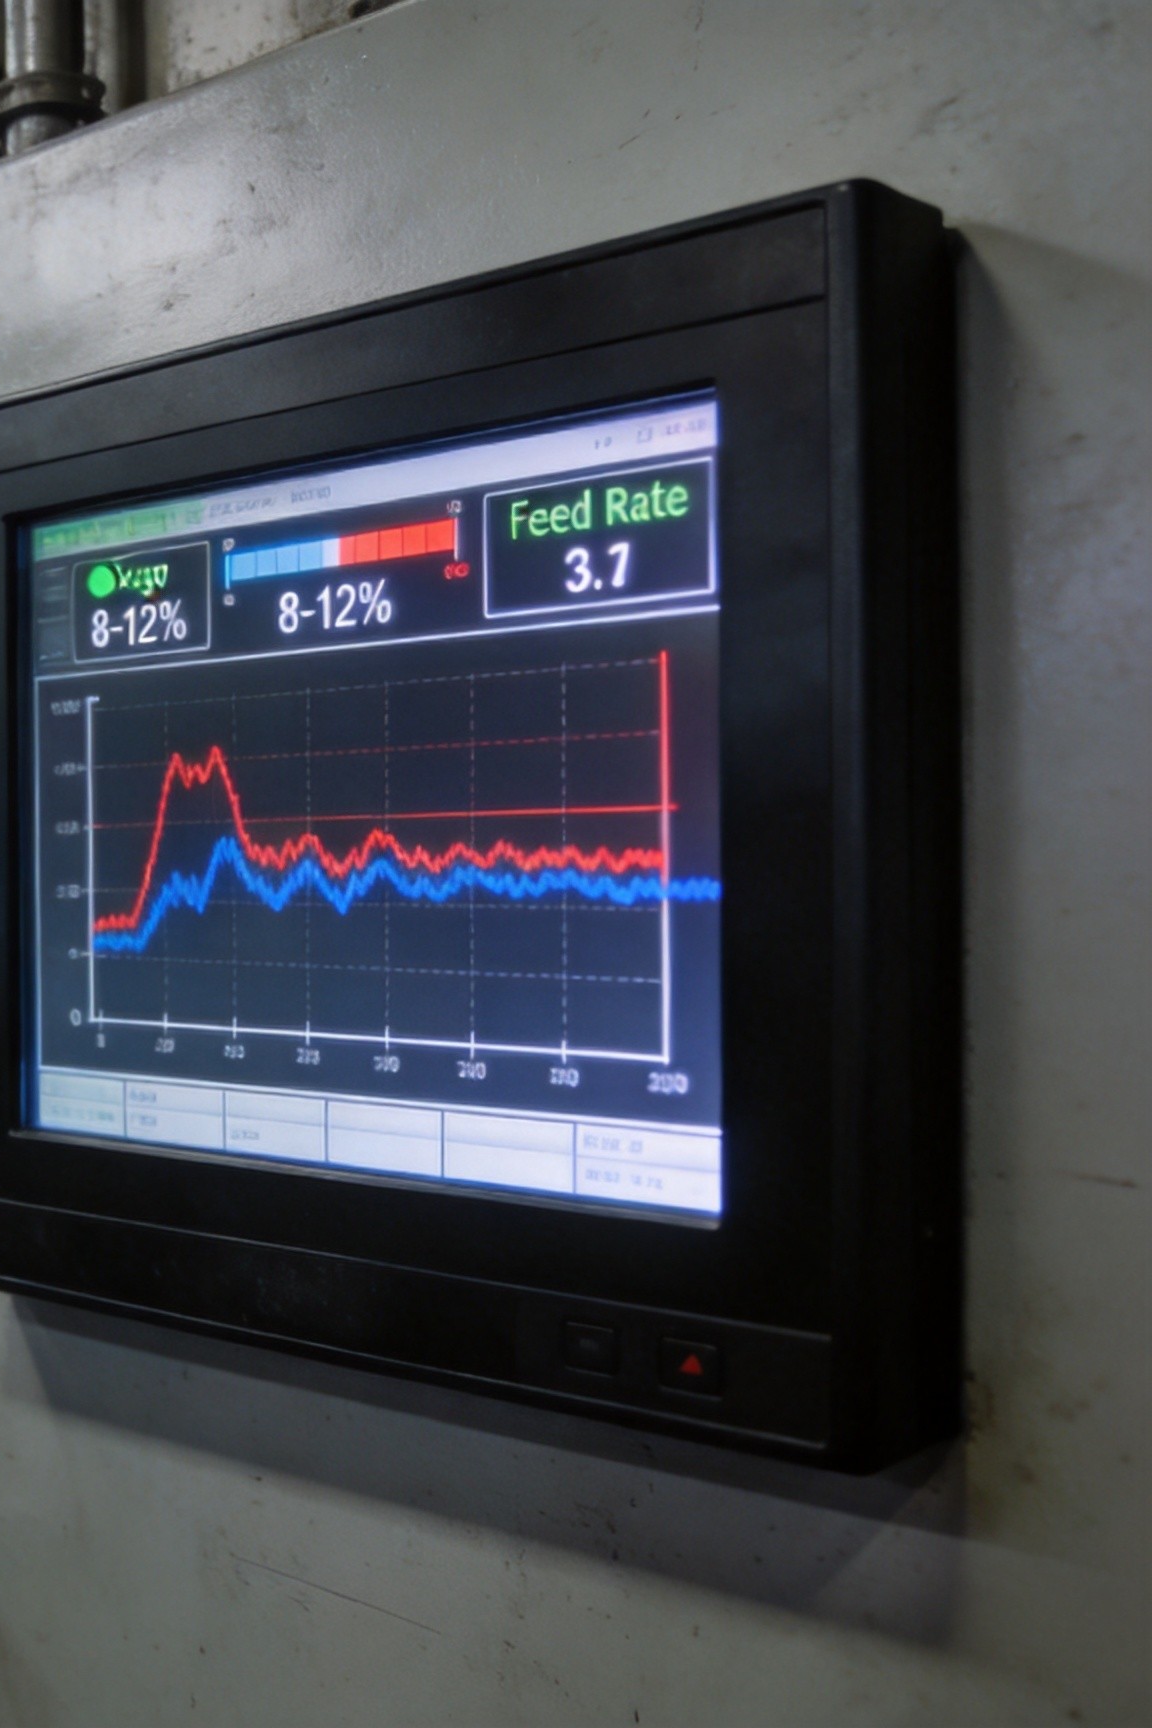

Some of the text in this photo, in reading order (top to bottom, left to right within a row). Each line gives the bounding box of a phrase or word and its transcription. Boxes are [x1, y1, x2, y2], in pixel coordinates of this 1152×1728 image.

[510, 479, 690, 541] Feed Rate
[564, 541, 631, 594] 3.7
[91, 598, 188, 649] 8-12%
[278, 577, 393, 635] 8-12%
